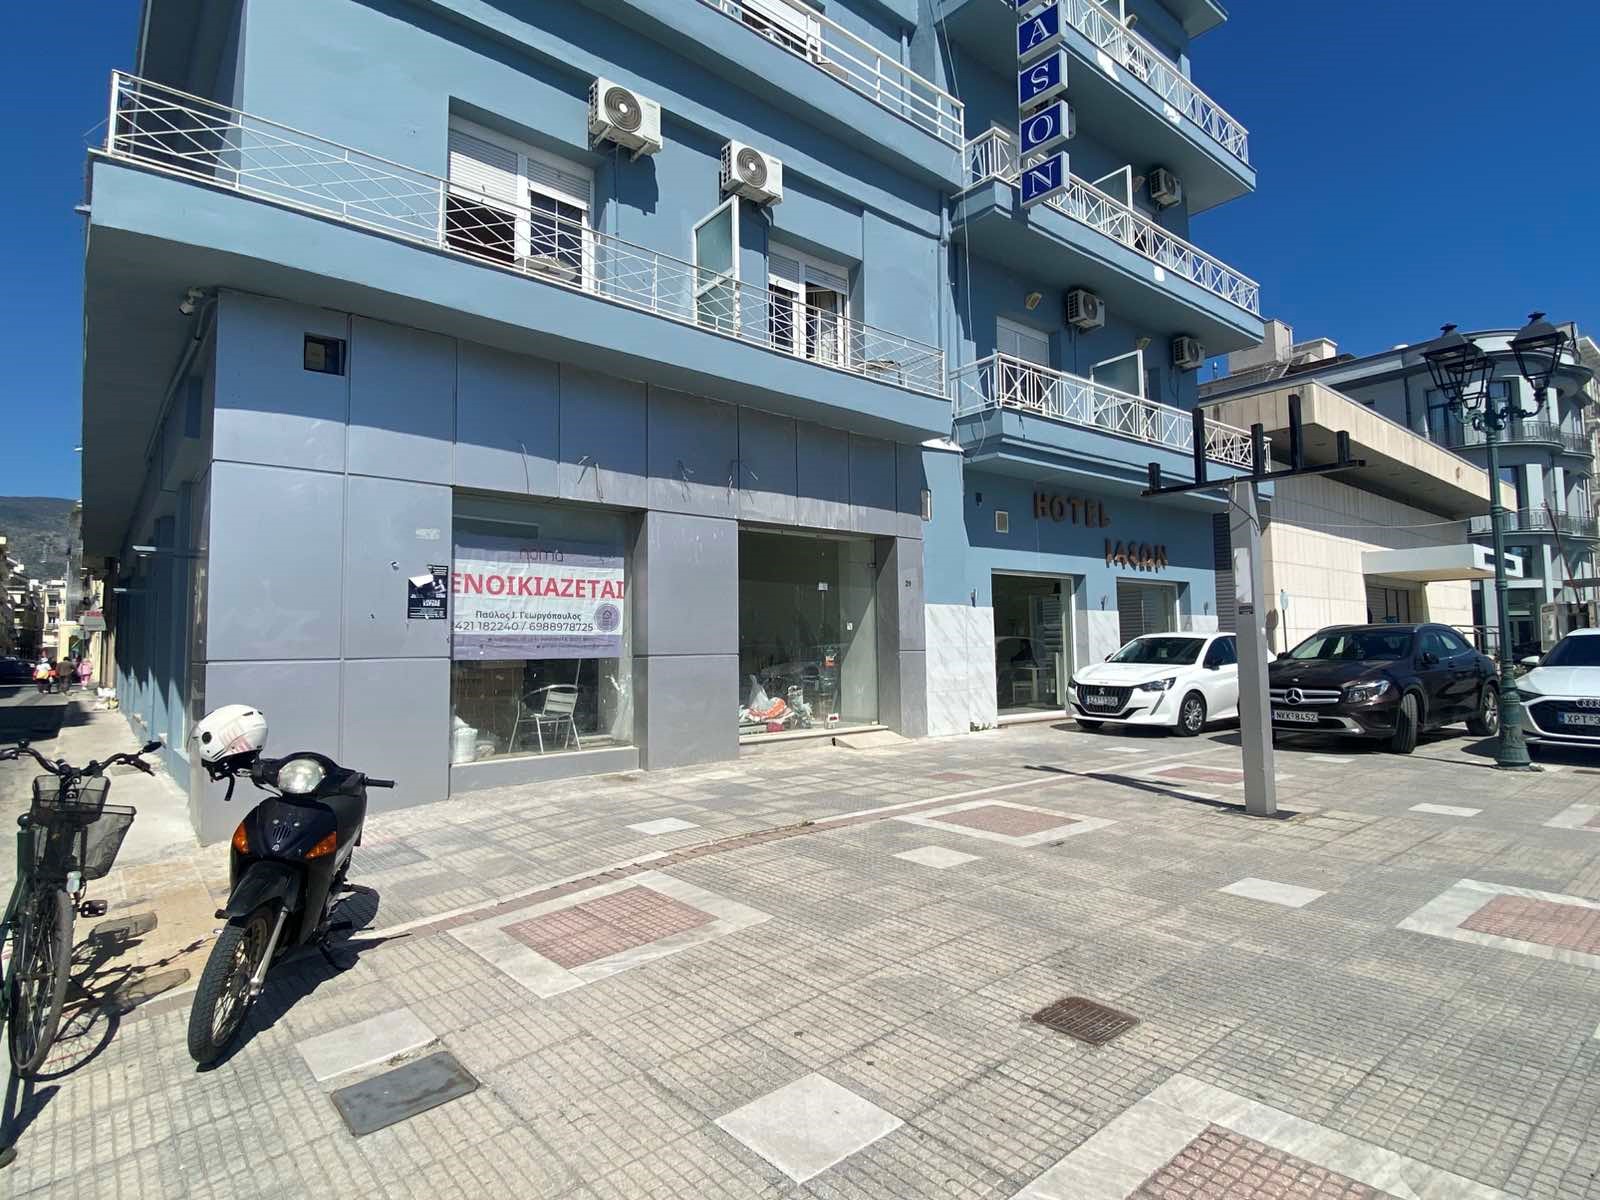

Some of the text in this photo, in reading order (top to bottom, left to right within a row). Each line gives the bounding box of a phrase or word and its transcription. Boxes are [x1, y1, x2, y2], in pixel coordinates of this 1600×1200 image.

[1033, 491, 1111, 528] HOTEL
[451, 573, 624, 599] ΕΝΟΙΚΙΑΖΕΤΑΙ
[475, 610, 510, 621] Παύλος
[452, 621, 474, 631] 421
[477, 622, 518, 631] 182240
